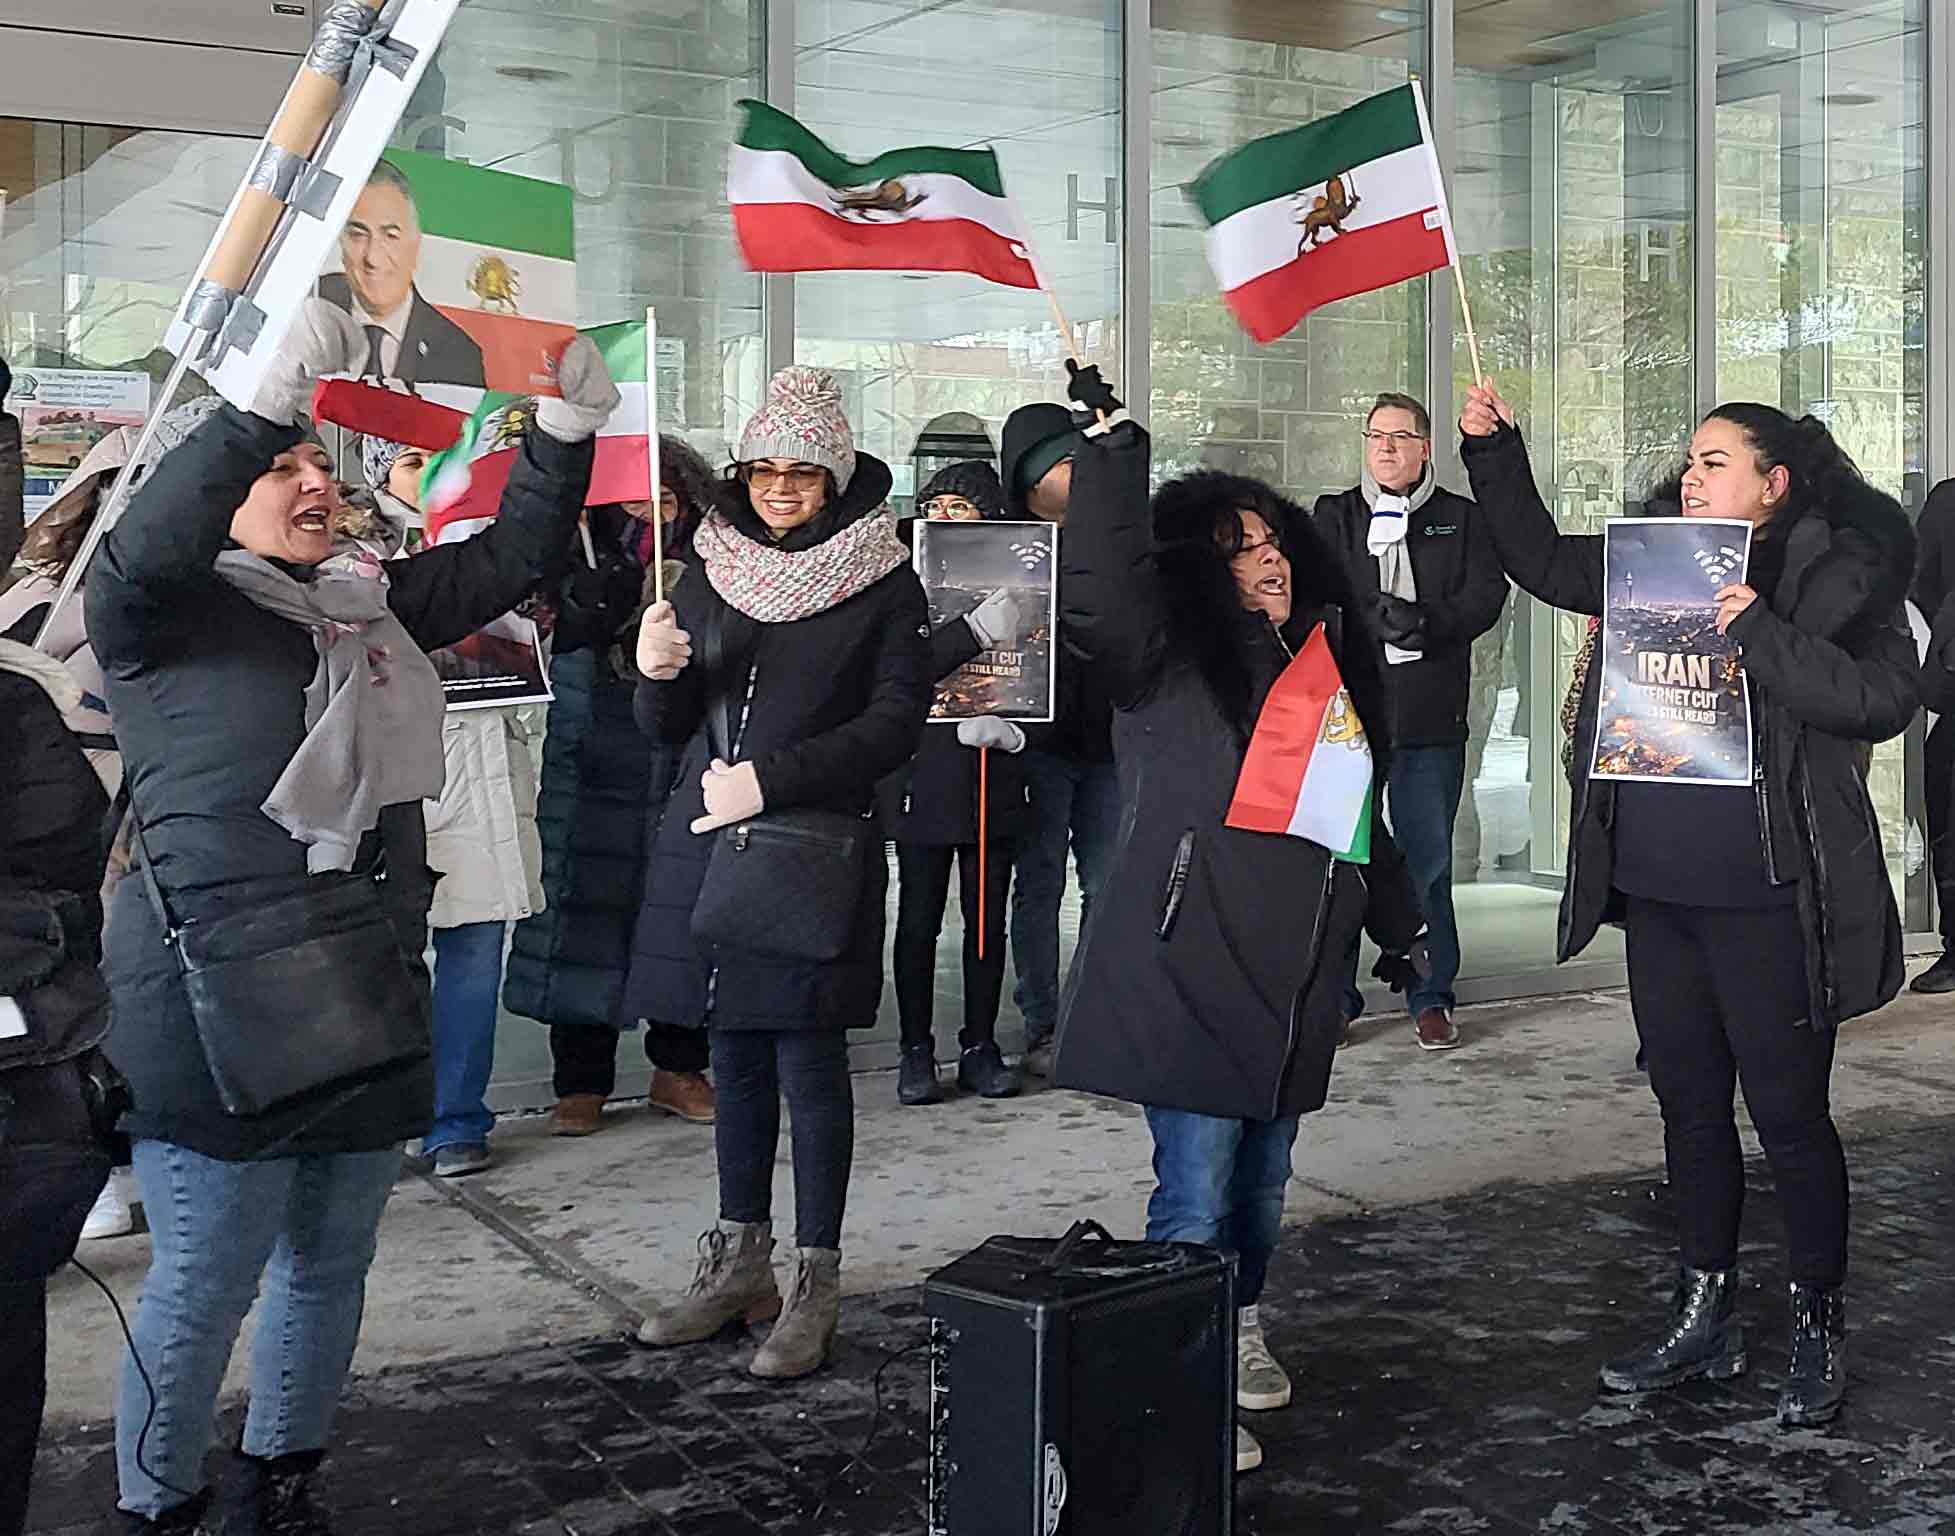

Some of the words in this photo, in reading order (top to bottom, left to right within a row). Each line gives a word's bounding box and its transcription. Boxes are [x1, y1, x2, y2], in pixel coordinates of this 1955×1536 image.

[1000, 651, 1024, 666] CUT
[1637, 651, 1712, 689] IRAN
[1691, 688, 1719, 710] CUT
